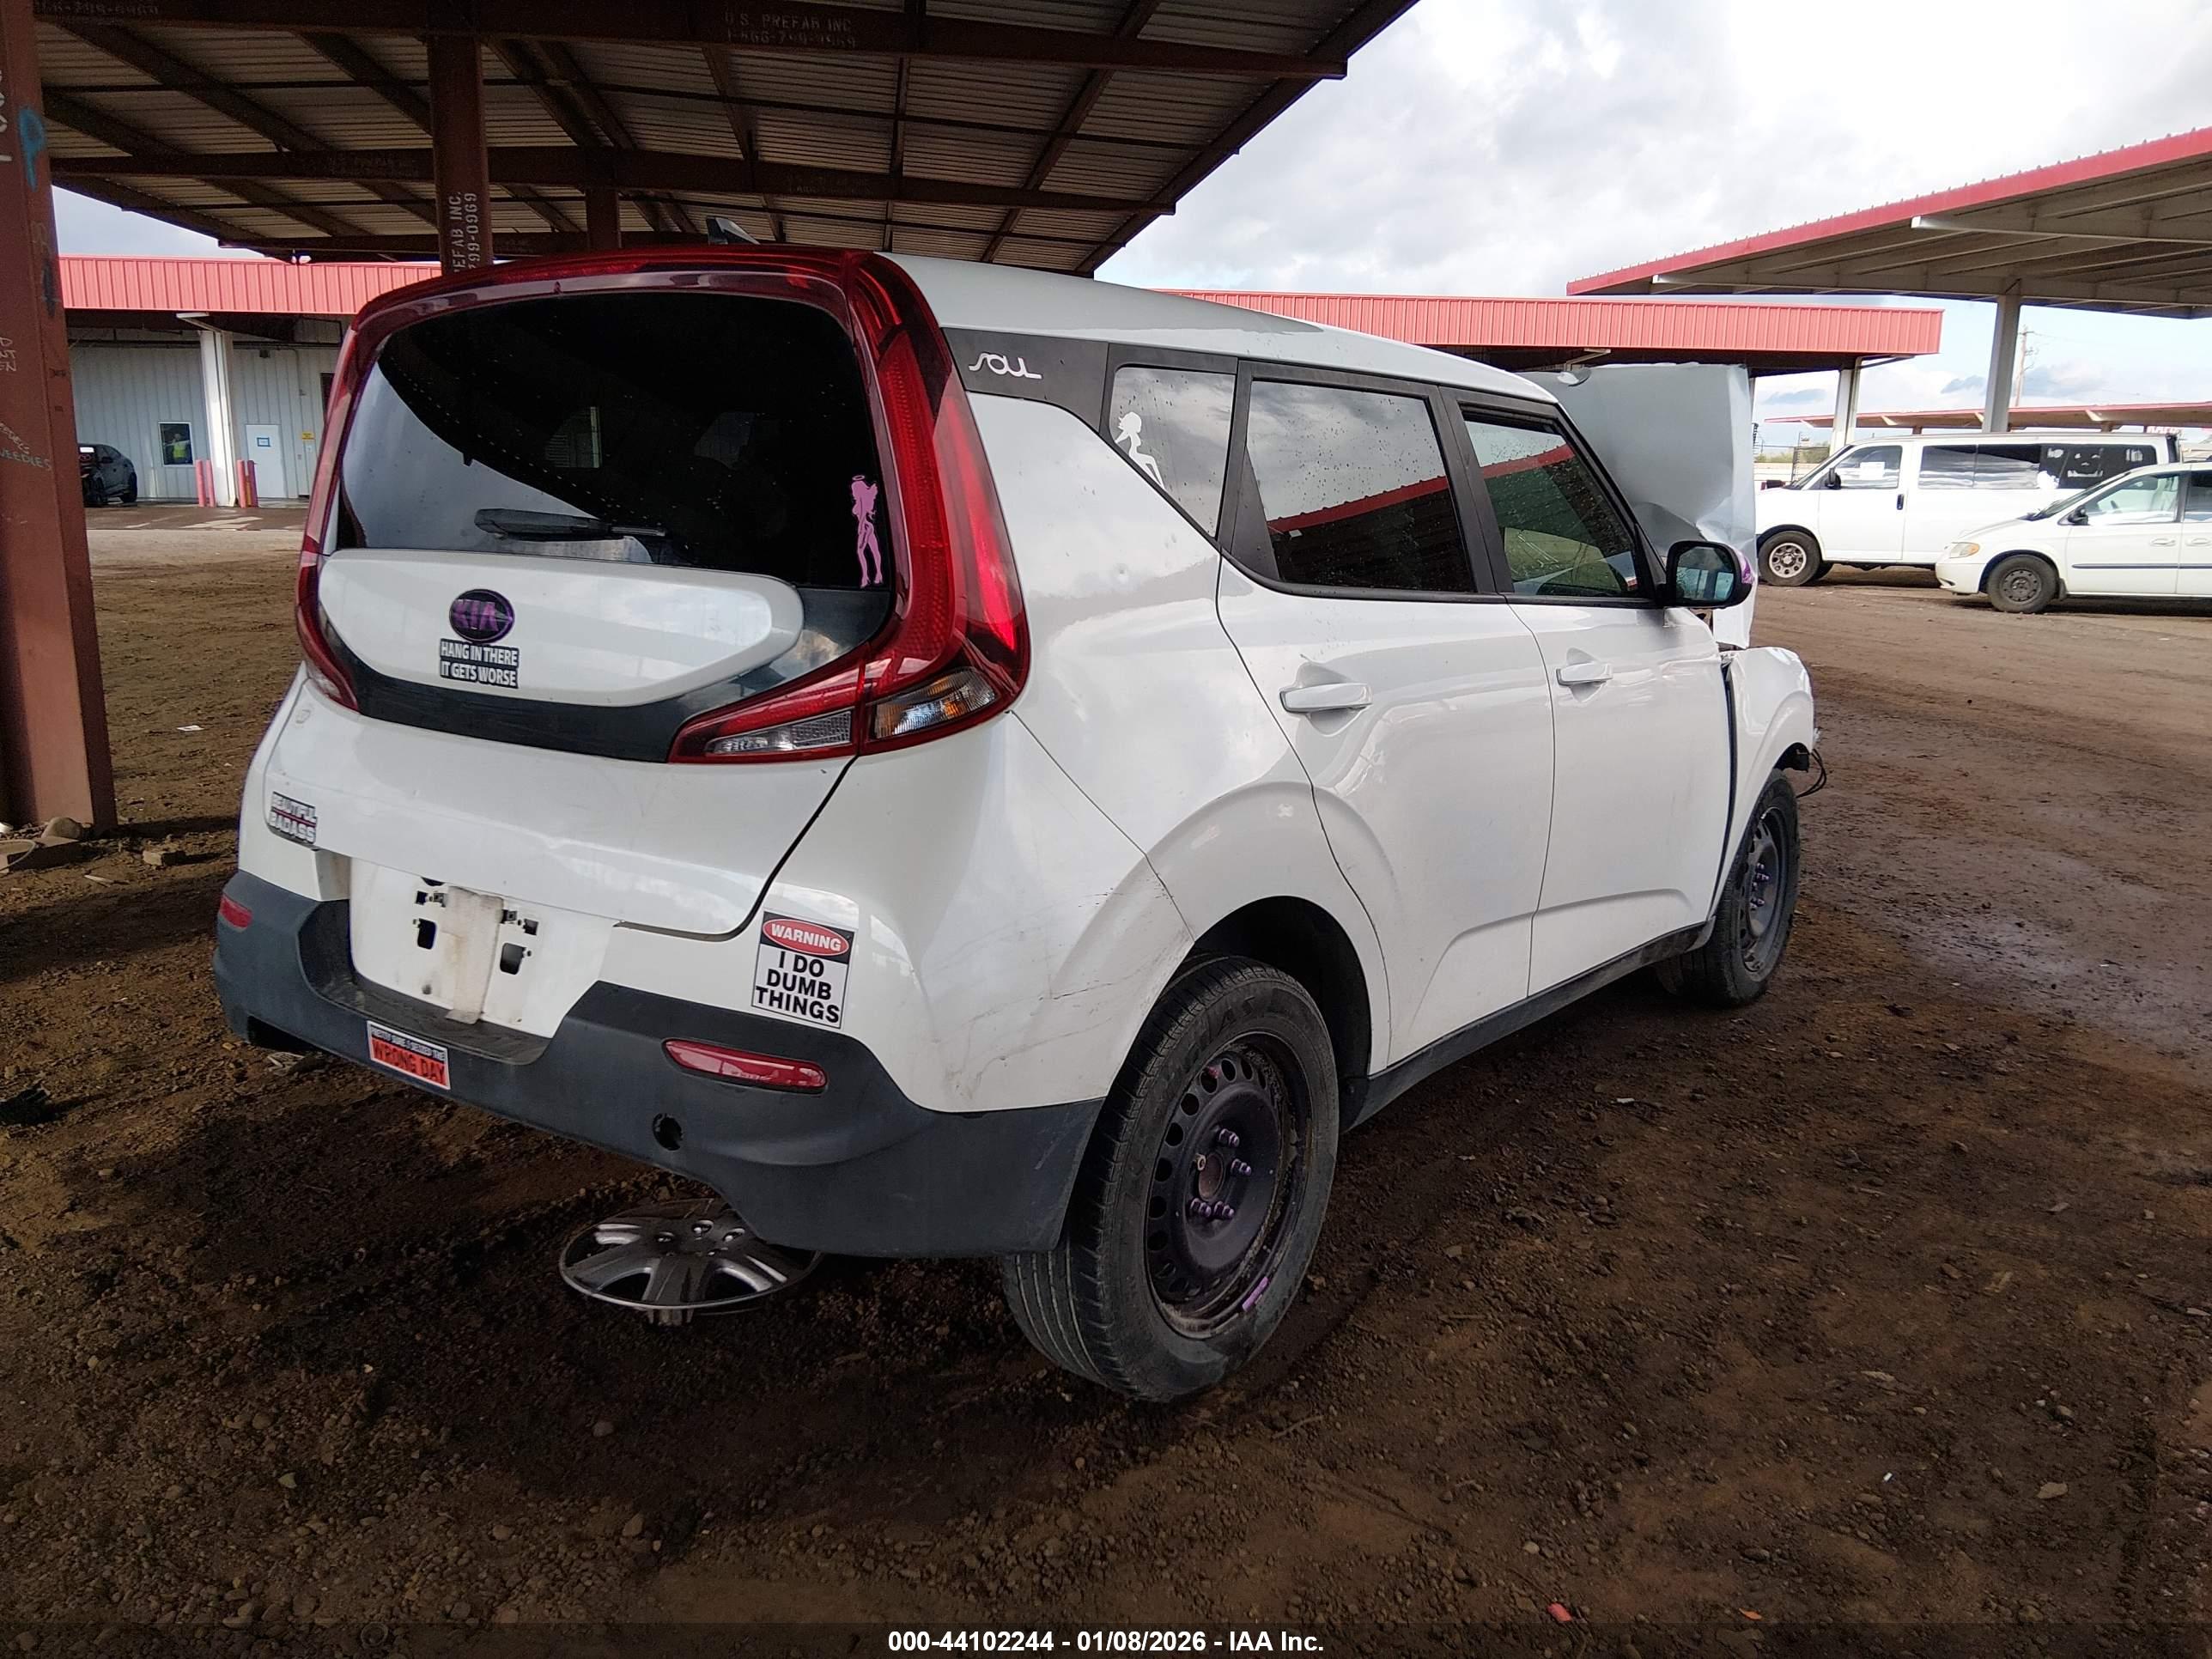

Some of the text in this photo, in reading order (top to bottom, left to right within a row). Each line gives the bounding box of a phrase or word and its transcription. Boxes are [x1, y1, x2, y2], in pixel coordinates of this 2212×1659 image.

[448, 191, 463, 221] INC.
[452, 598, 499, 632] KIA
[441, 641, 519, 667] HANG IN THERE
[440, 660, 517, 687] IT GETS WORSE
[770, 923, 842, 951] WARNING
[778, 951, 824, 977] I DO
[766, 969, 832, 1000] DUMB
[755, 985, 841, 1024] THINGS
[372, 1038, 446, 1087] WRONG DAY
